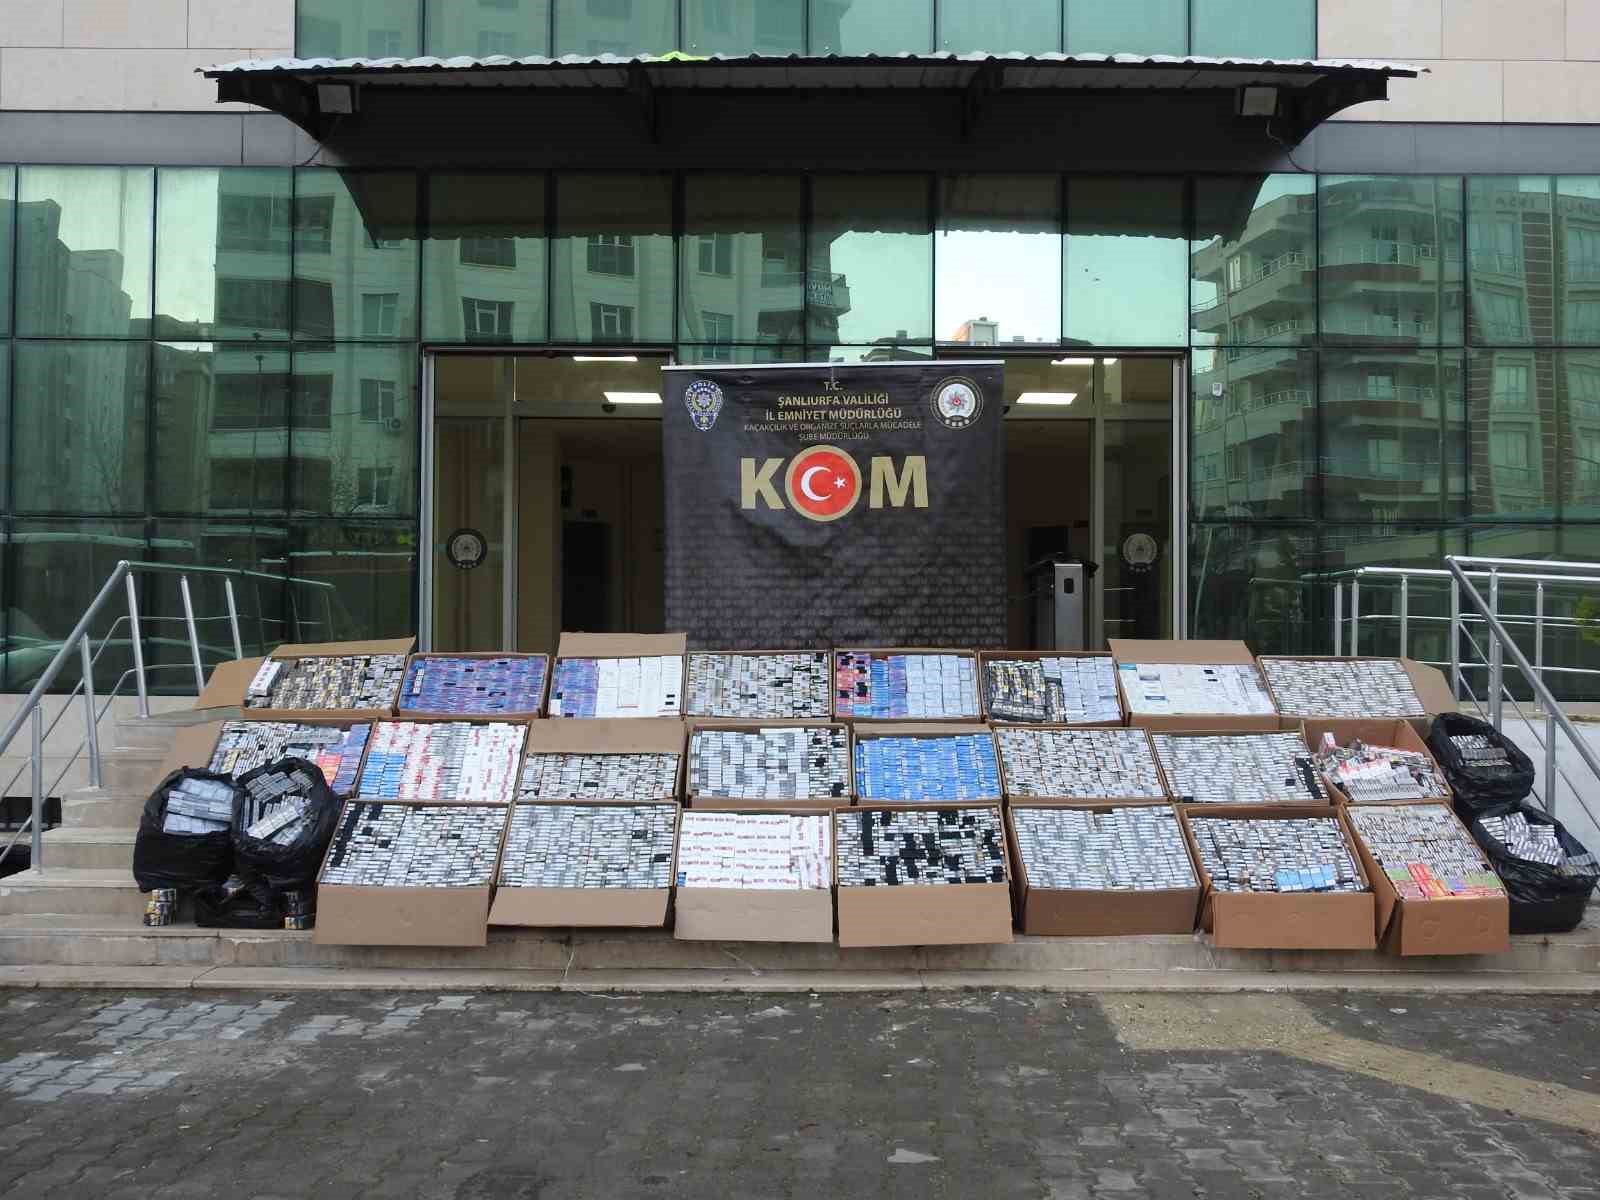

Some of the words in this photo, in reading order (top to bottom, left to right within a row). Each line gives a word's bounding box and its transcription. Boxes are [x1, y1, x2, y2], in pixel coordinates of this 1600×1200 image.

[778, 396, 841, 408] ŞANLIURFA
[843, 392, 889, 405] VALİLİĞİ
[765, 408, 775, 421] İL
[777, 408, 827, 421] EMNİYET
[828, 407, 902, 420] MÜDÜRLÜĞÜ
